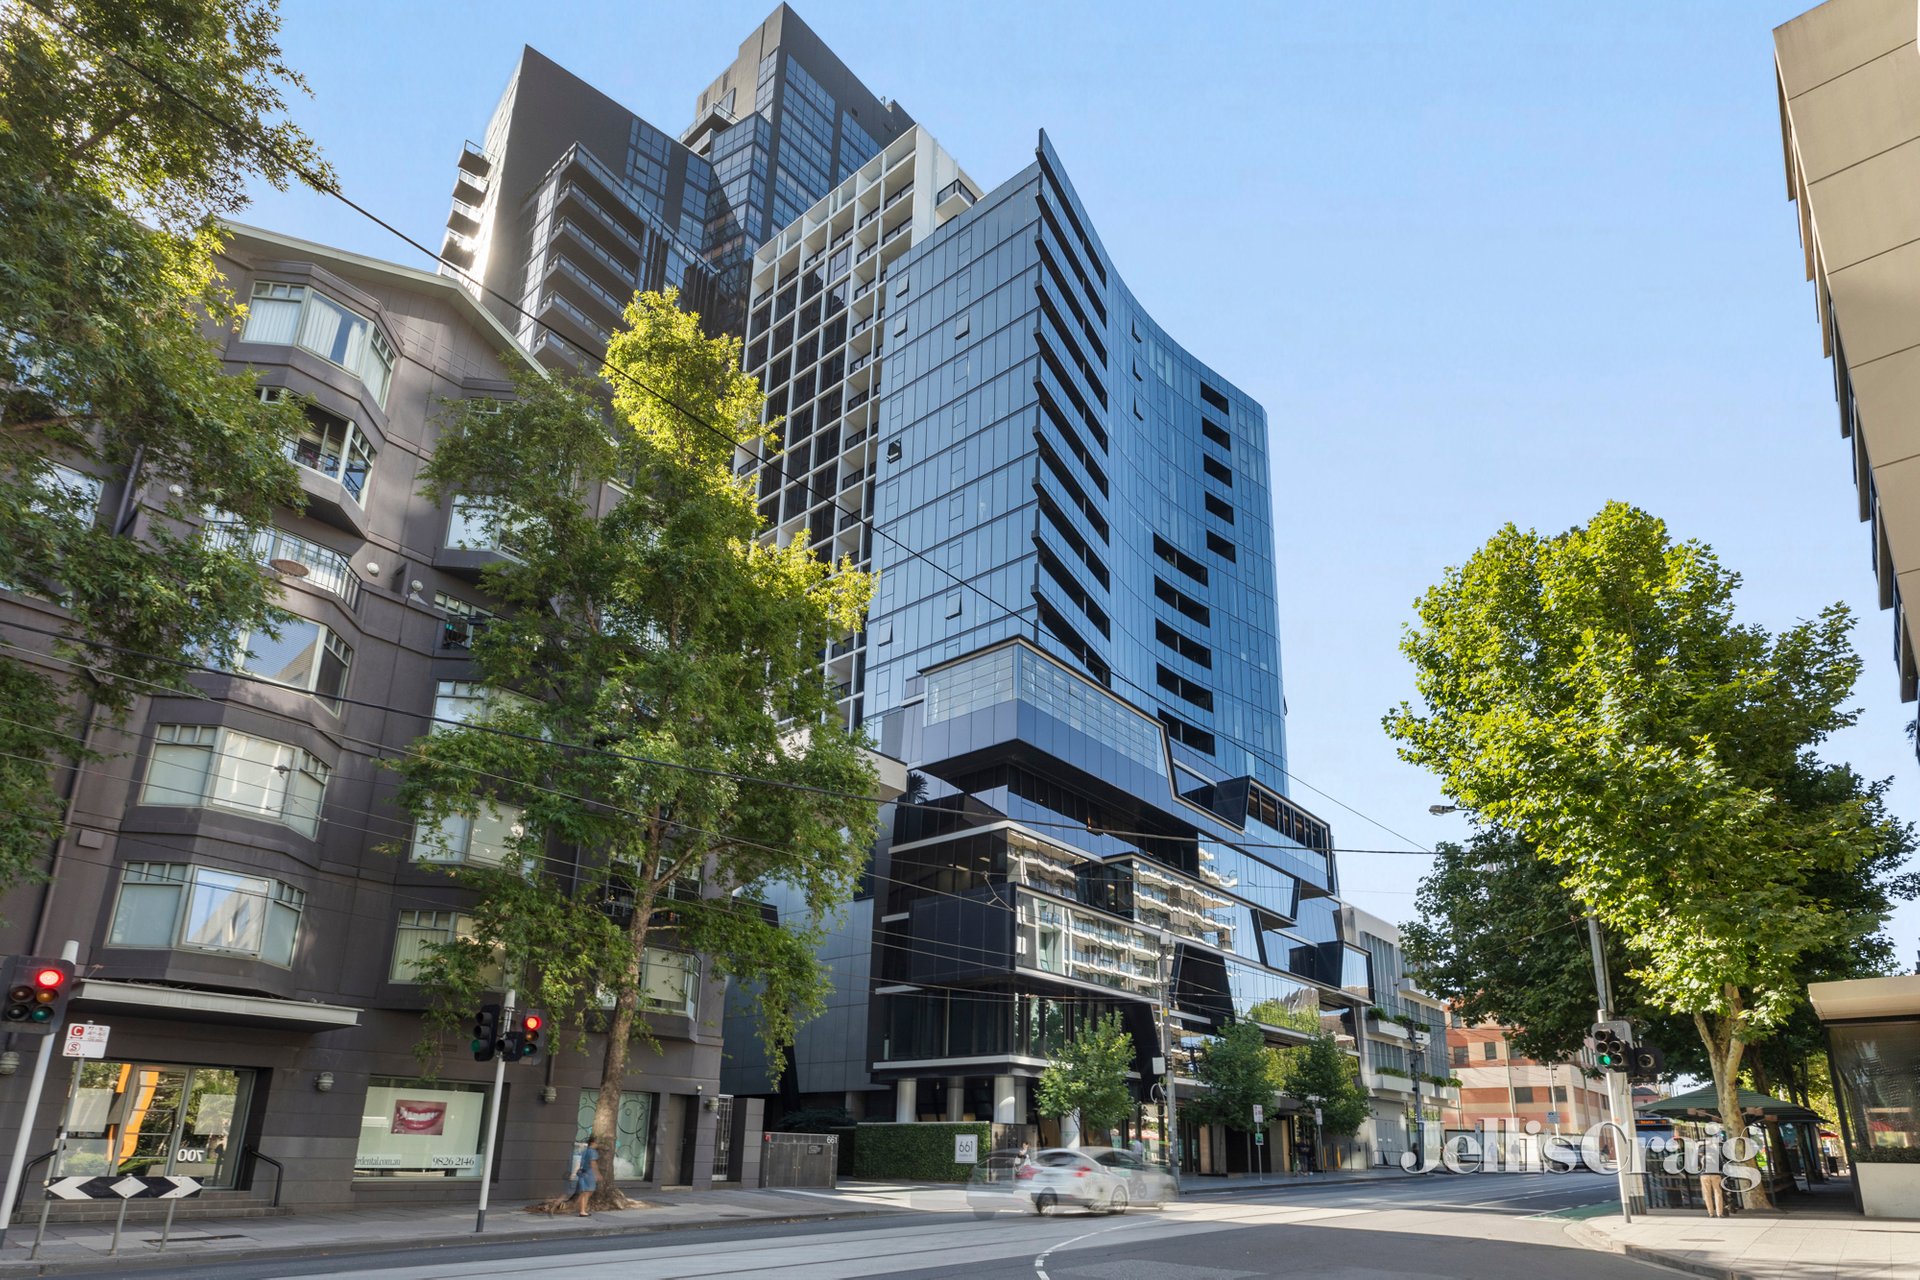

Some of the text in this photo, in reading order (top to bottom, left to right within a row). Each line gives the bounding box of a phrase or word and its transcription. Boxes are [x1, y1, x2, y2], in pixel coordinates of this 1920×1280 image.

[73, 1026, 82, 1036] C
[71, 1043, 78, 1051] S
[826, 1135, 838, 1144] 661
[959, 1140, 973, 1153] 661
[432, 1156, 475, 1166] 9826 2146
